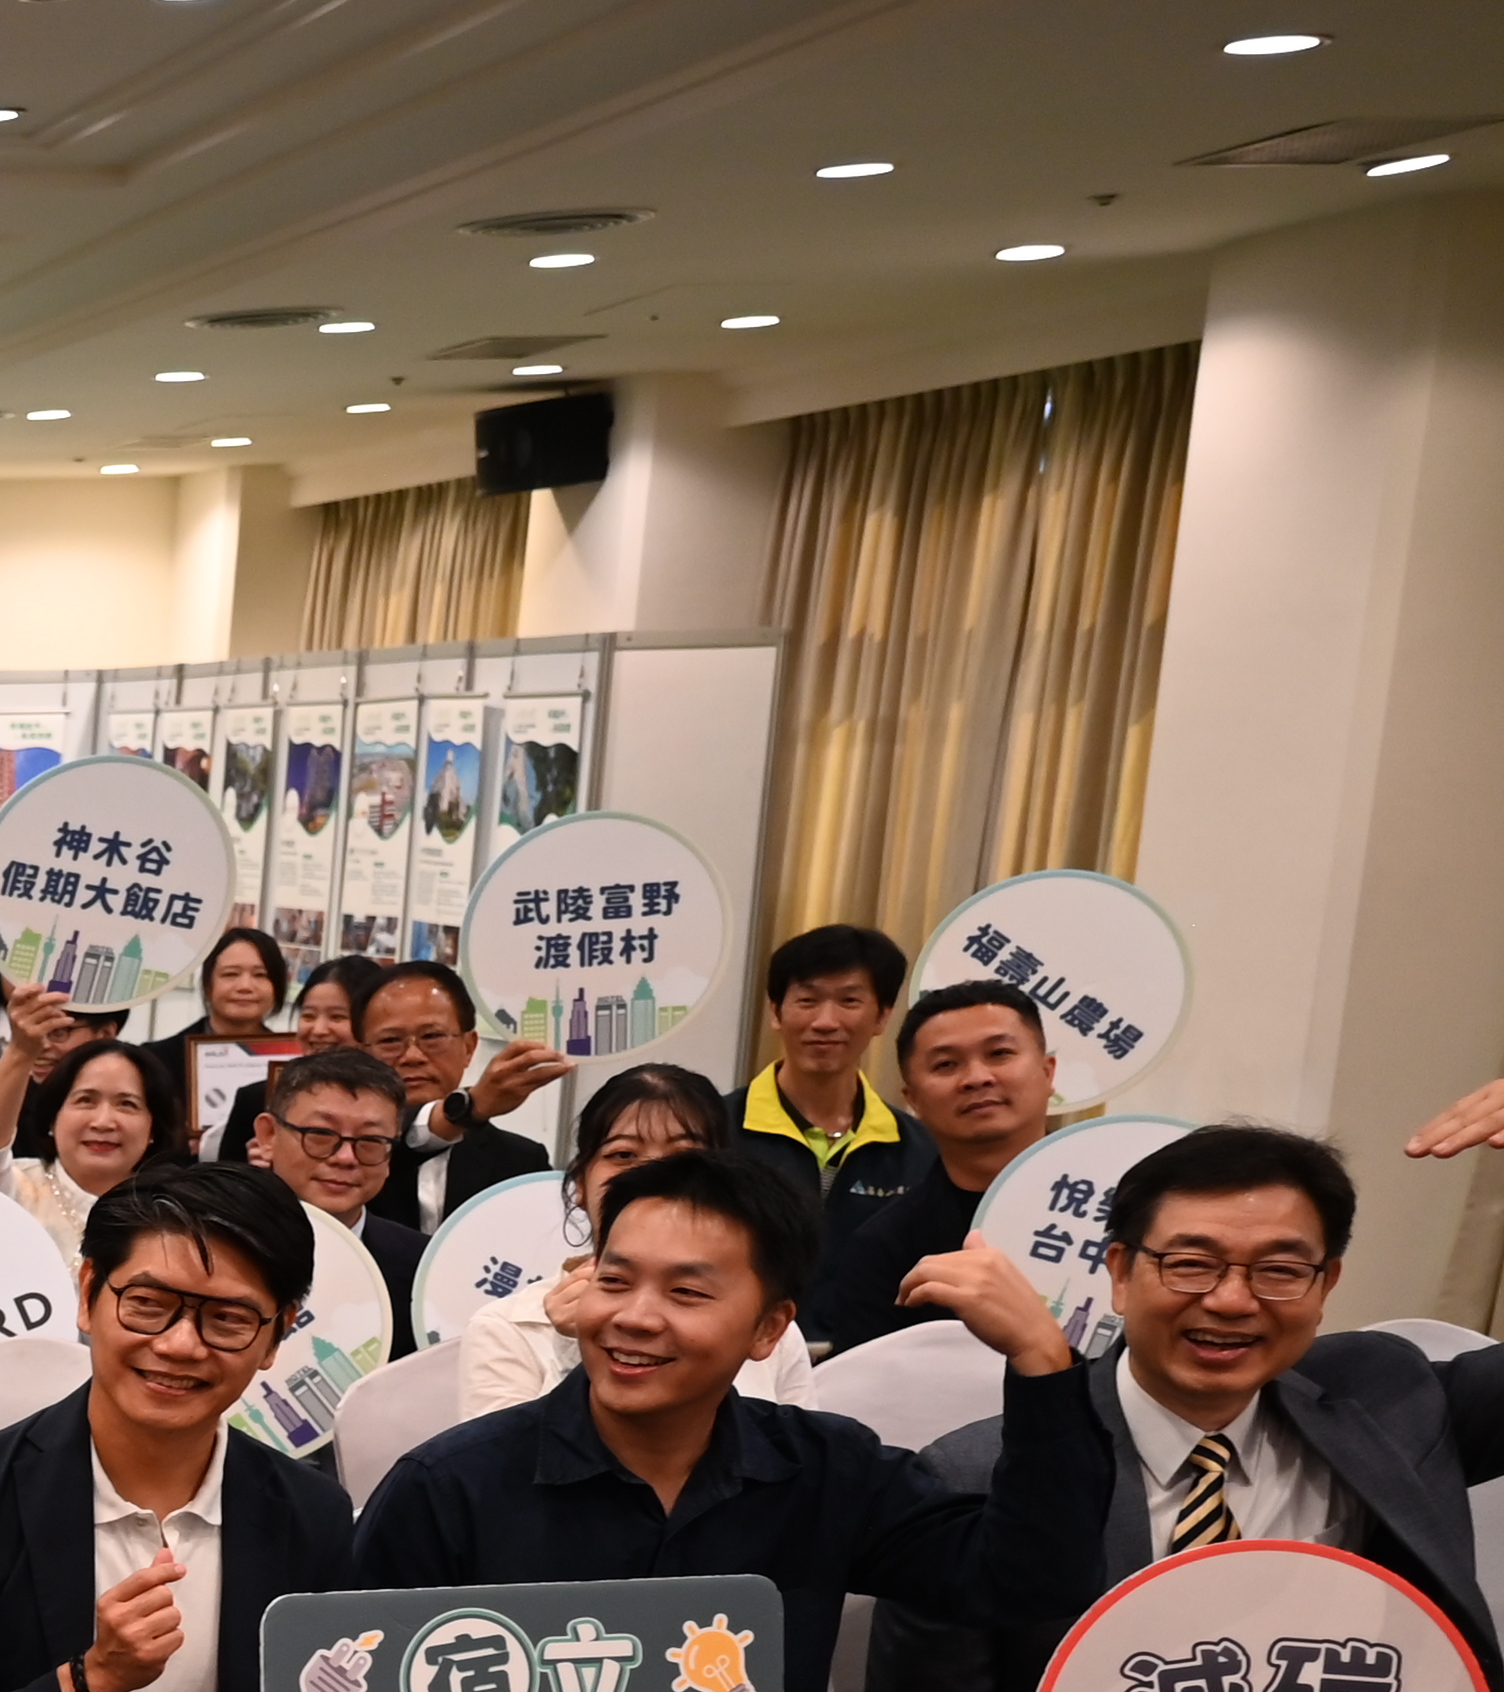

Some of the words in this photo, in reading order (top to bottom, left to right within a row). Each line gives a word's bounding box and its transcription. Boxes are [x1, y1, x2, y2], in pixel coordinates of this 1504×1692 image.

[52, 821, 174, 877] 神木谷
[0, 860, 204, 930] 假期大飯店
[512, 880, 681, 926] 武陵富野
[534, 927, 659, 970] 渡假村
[961, 923, 1144, 1060] 福壽山農場
